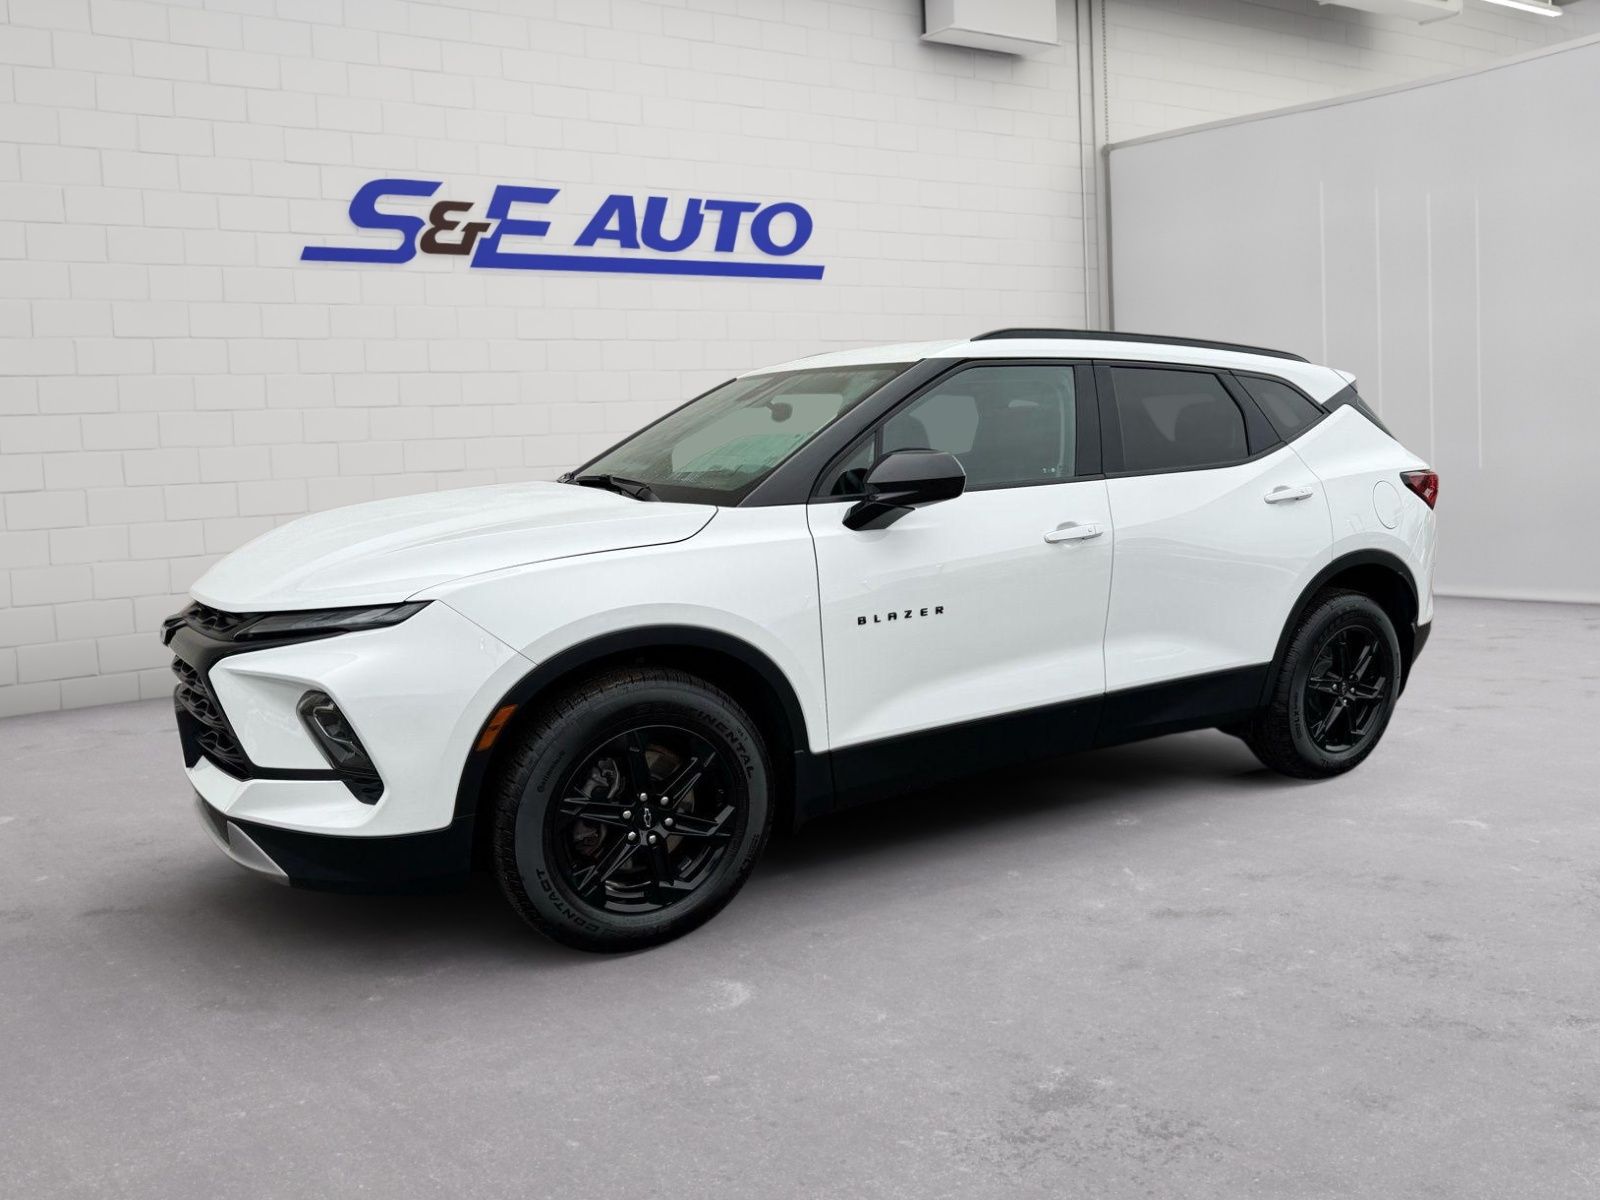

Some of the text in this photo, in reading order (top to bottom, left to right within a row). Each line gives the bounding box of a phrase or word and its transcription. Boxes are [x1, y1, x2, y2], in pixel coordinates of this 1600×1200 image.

[300, 178, 814, 269] S&E AUTO
[857, 605, 945, 626] BLAZER
[535, 868, 602, 933] CONTACT
